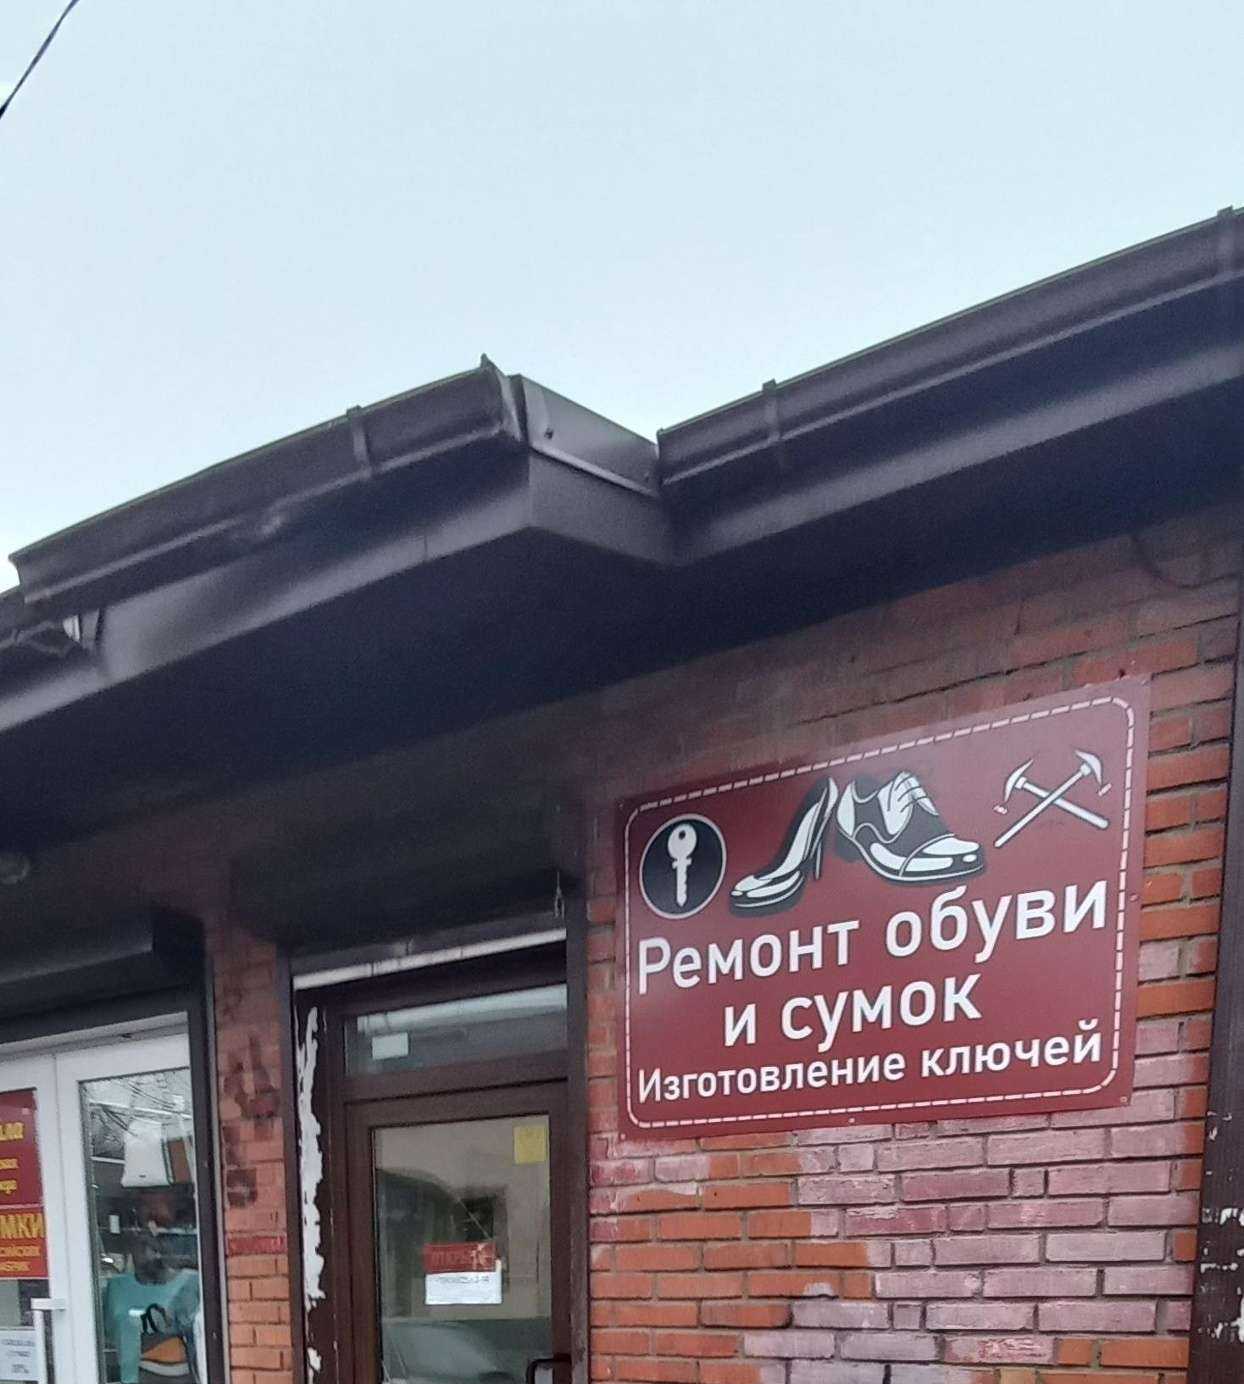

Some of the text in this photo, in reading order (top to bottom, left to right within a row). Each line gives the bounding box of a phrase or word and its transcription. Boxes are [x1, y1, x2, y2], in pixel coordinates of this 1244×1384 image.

[638, 880, 1108, 996] Ремонт обуви
[723, 973, 983, 1053] и сумок
[638, 1019, 1102, 1104] Изготовление ключей
